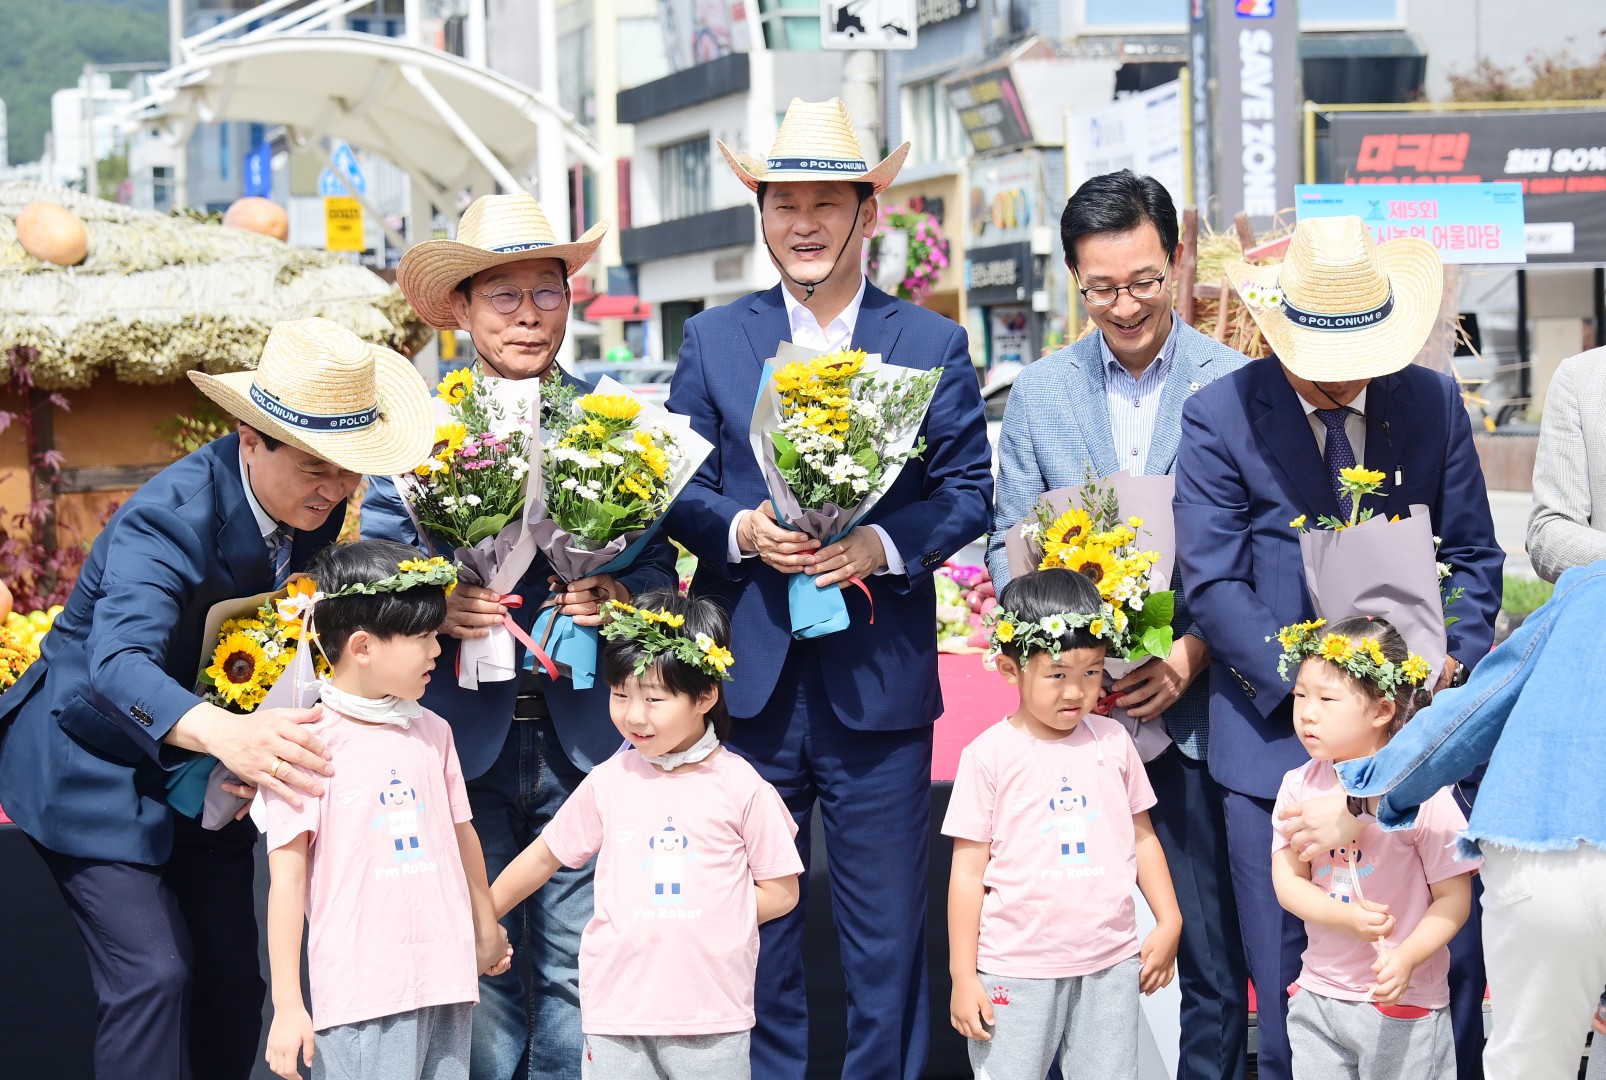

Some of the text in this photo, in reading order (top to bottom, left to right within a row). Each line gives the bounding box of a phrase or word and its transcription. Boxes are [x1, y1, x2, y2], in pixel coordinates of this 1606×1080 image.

[1239, 28, 1277, 217] SAVE ZONE
[1356, 132, 1470, 172] 대국민
[809, 160, 863, 171] POLONIUM
[1388, 200, 1438, 219] 제5회
[1432, 224, 1501, 250] 어물마당
[1308, 313, 1374, 327] POLONIUM
[252, 391, 299, 424] POLONIUM
[374, 866, 400, 880] I'm
[1040, 864, 1106, 880] I'm Robot
[1333, 873, 1353, 885] HELLO
[633, 906, 703, 920] I'm Robot
